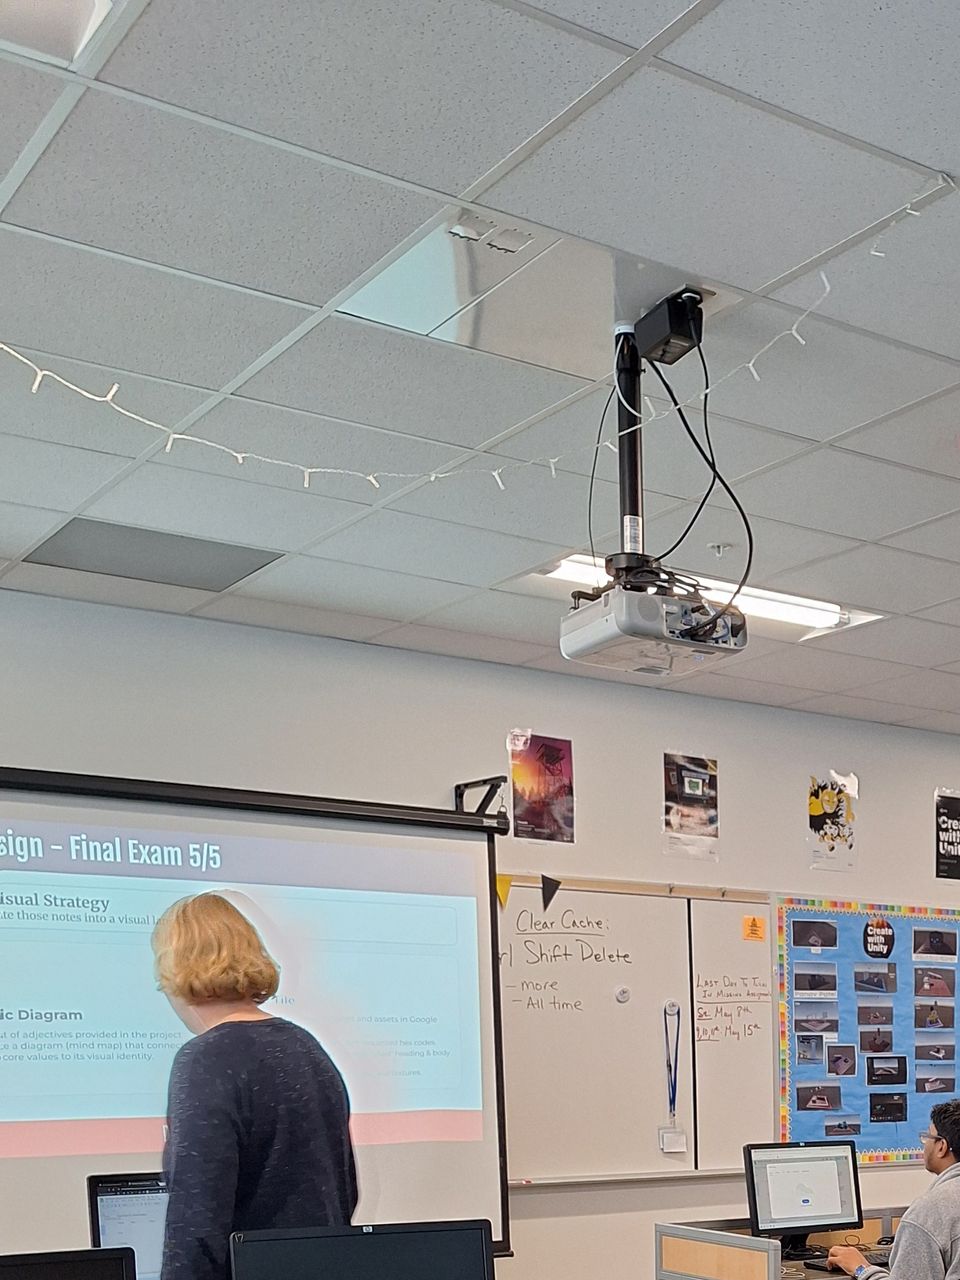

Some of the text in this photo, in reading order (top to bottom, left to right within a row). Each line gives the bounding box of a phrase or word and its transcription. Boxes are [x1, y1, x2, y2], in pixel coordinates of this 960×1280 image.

[69, 833, 121, 862] Final
[128, 839, 182, 866] Exam
[189, 843, 221, 872] 5/5
[0, 892, 109, 912] isual Strategy
[17, 910, 49, 921] those
[52, 913, 82, 923] notes
[84, 912, 107, 923] into
[109, 916, 115, 924] a
[117, 914, 150, 925] visual
[516, 909, 610, 932] Clear Cache:
[867, 926, 893, 935] Create
[867, 936, 885, 944] with
[523, 939, 573, 964] Shift
[575, 939, 632, 964] Delete
[867, 944, 888, 953] Unity
[521, 980, 558, 991] more
[526, 996, 583, 1011] All time
[18, 1008, 83, 1022] Diagram
[401, 1015, 408, 1023] in
[409, 1015, 438, 1024] Google
[714, 1005, 732, 1024] May
[22, 1030, 74, 1041] adjectives
[75, 1031, 118, 1041] provided
[131, 1031, 147, 1039] the
[150, 1031, 182, 1042] project
[724, 1025, 740, 1040] May
[20, 1042, 64, 1051] diagram
[65, 1042, 95, 1051] (mind
[97, 1042, 122, 1051] map)
[27, 1053, 59, 1061] values
[87, 1053, 114, 1061] visual
